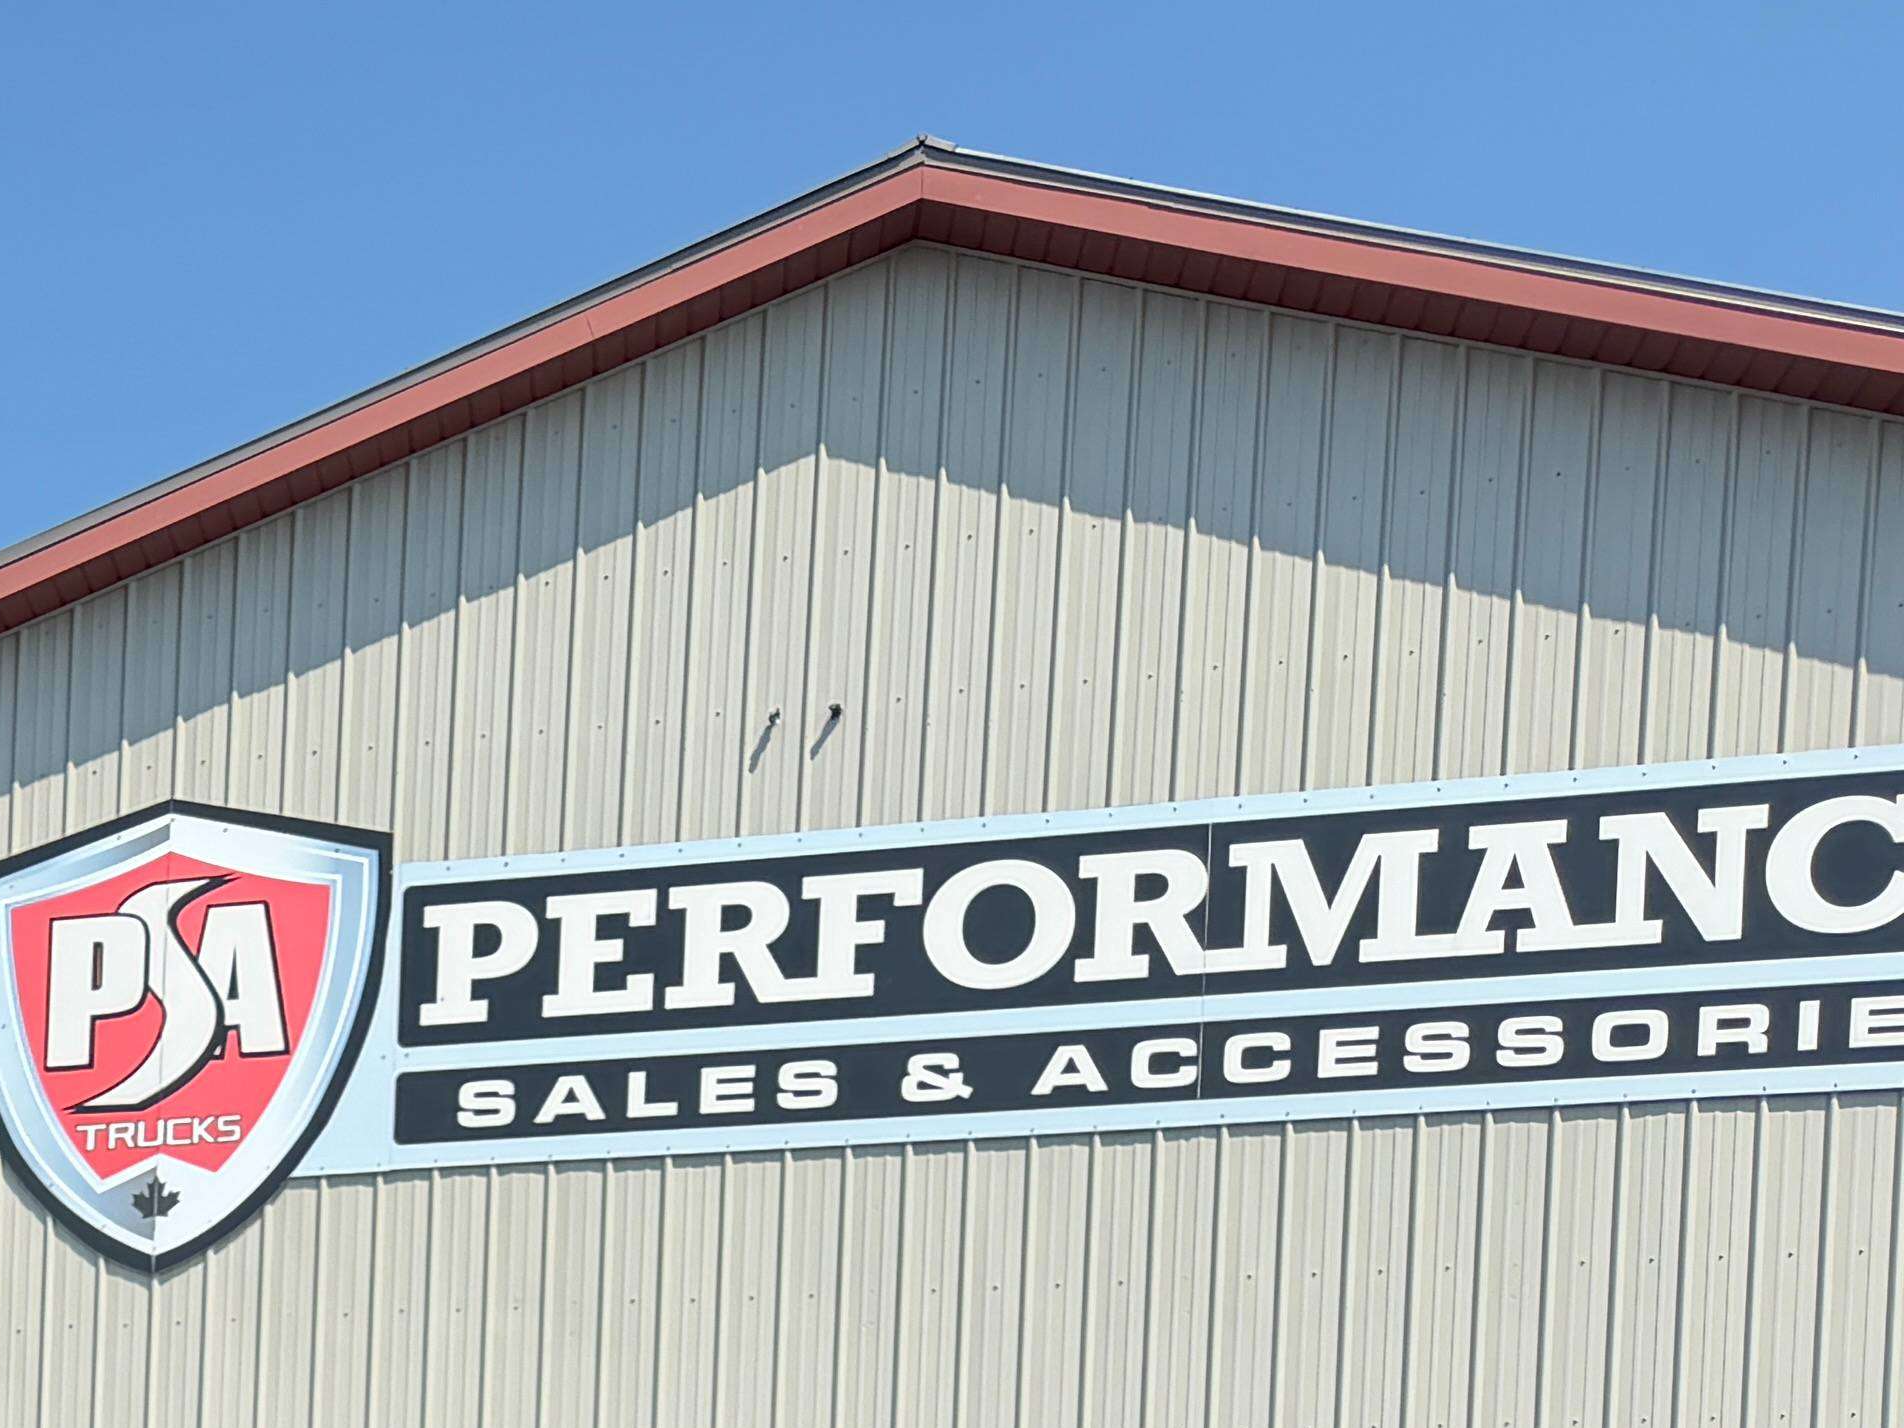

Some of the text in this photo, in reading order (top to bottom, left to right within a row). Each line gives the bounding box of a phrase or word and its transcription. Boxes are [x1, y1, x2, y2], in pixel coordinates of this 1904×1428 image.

[44, 875, 291, 1112] PSA
[456, 1059, 839, 1128] SALES
[900, 1051, 974, 1103] &
[75, 1114, 242, 1152] TRUCKS
